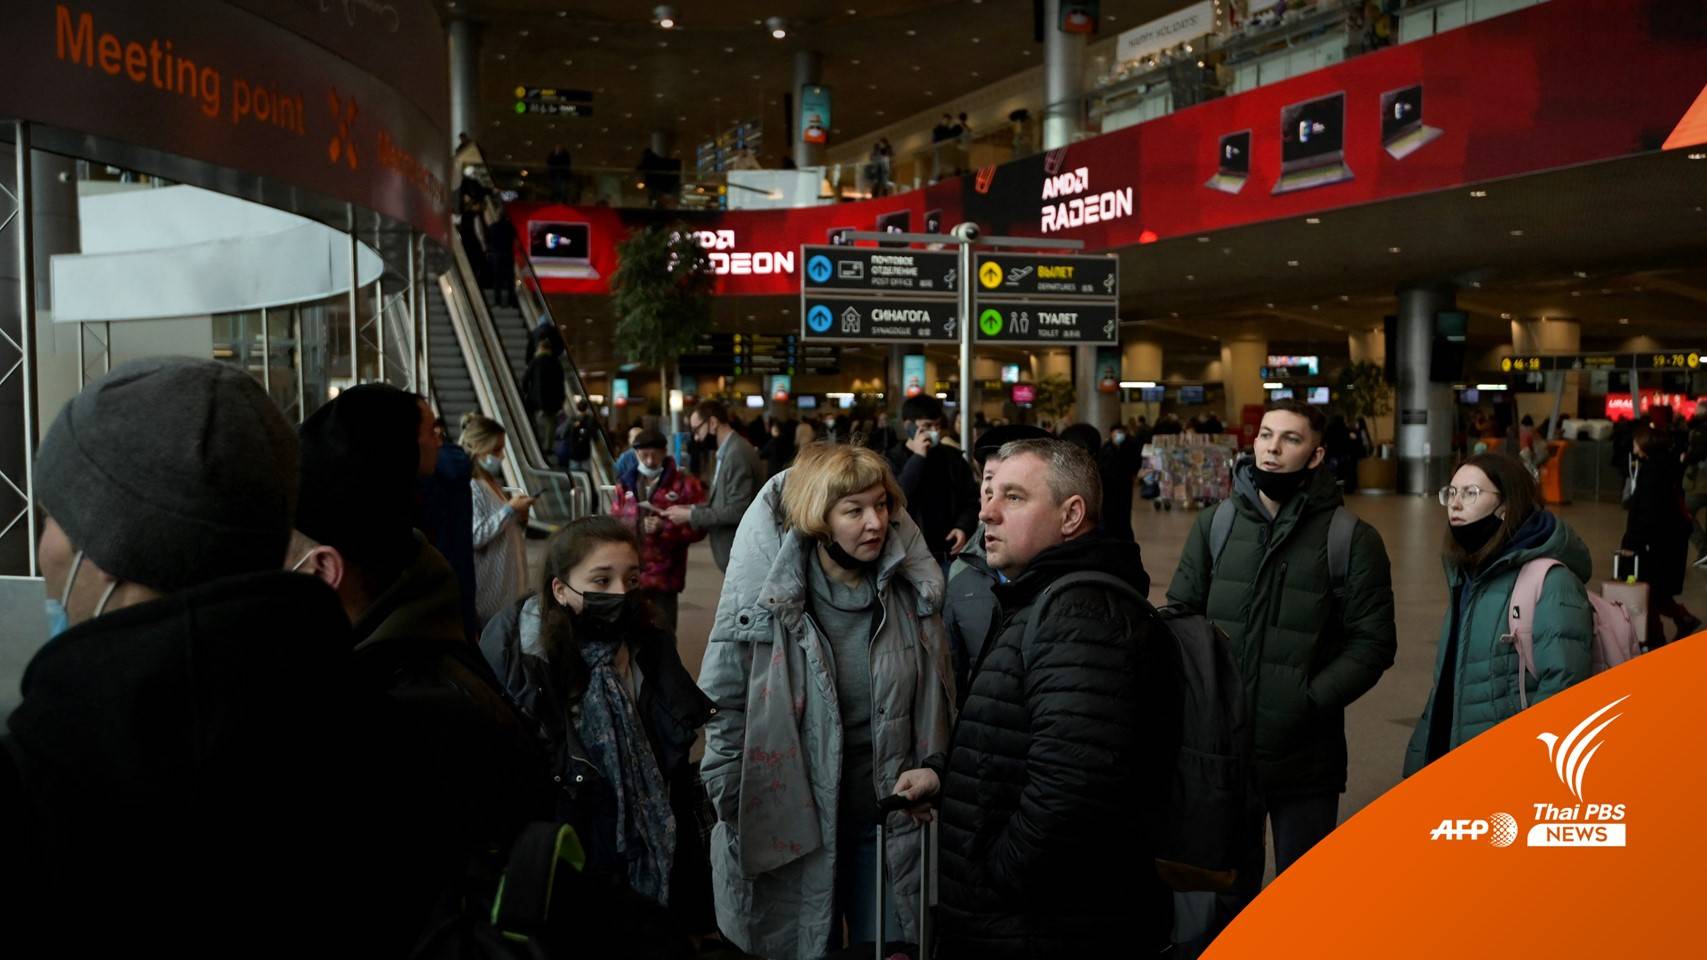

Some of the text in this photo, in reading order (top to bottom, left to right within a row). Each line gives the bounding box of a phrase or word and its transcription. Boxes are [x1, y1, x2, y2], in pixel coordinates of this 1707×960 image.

[55, 4, 304, 135] Meeting point
[1042, 171, 1078, 200] AMD
[1041, 187, 1133, 233] RADEON
[667, 251, 794, 275] DEON
[1037, 265, 1075, 279] ВЫЛЕТ
[871, 277, 888, 286] POST
[890, 277, 913, 287] OFFICE
[871, 308, 931, 323] СИНАГОГА
[1037, 312, 1079, 325] ТУАЛЕТ
